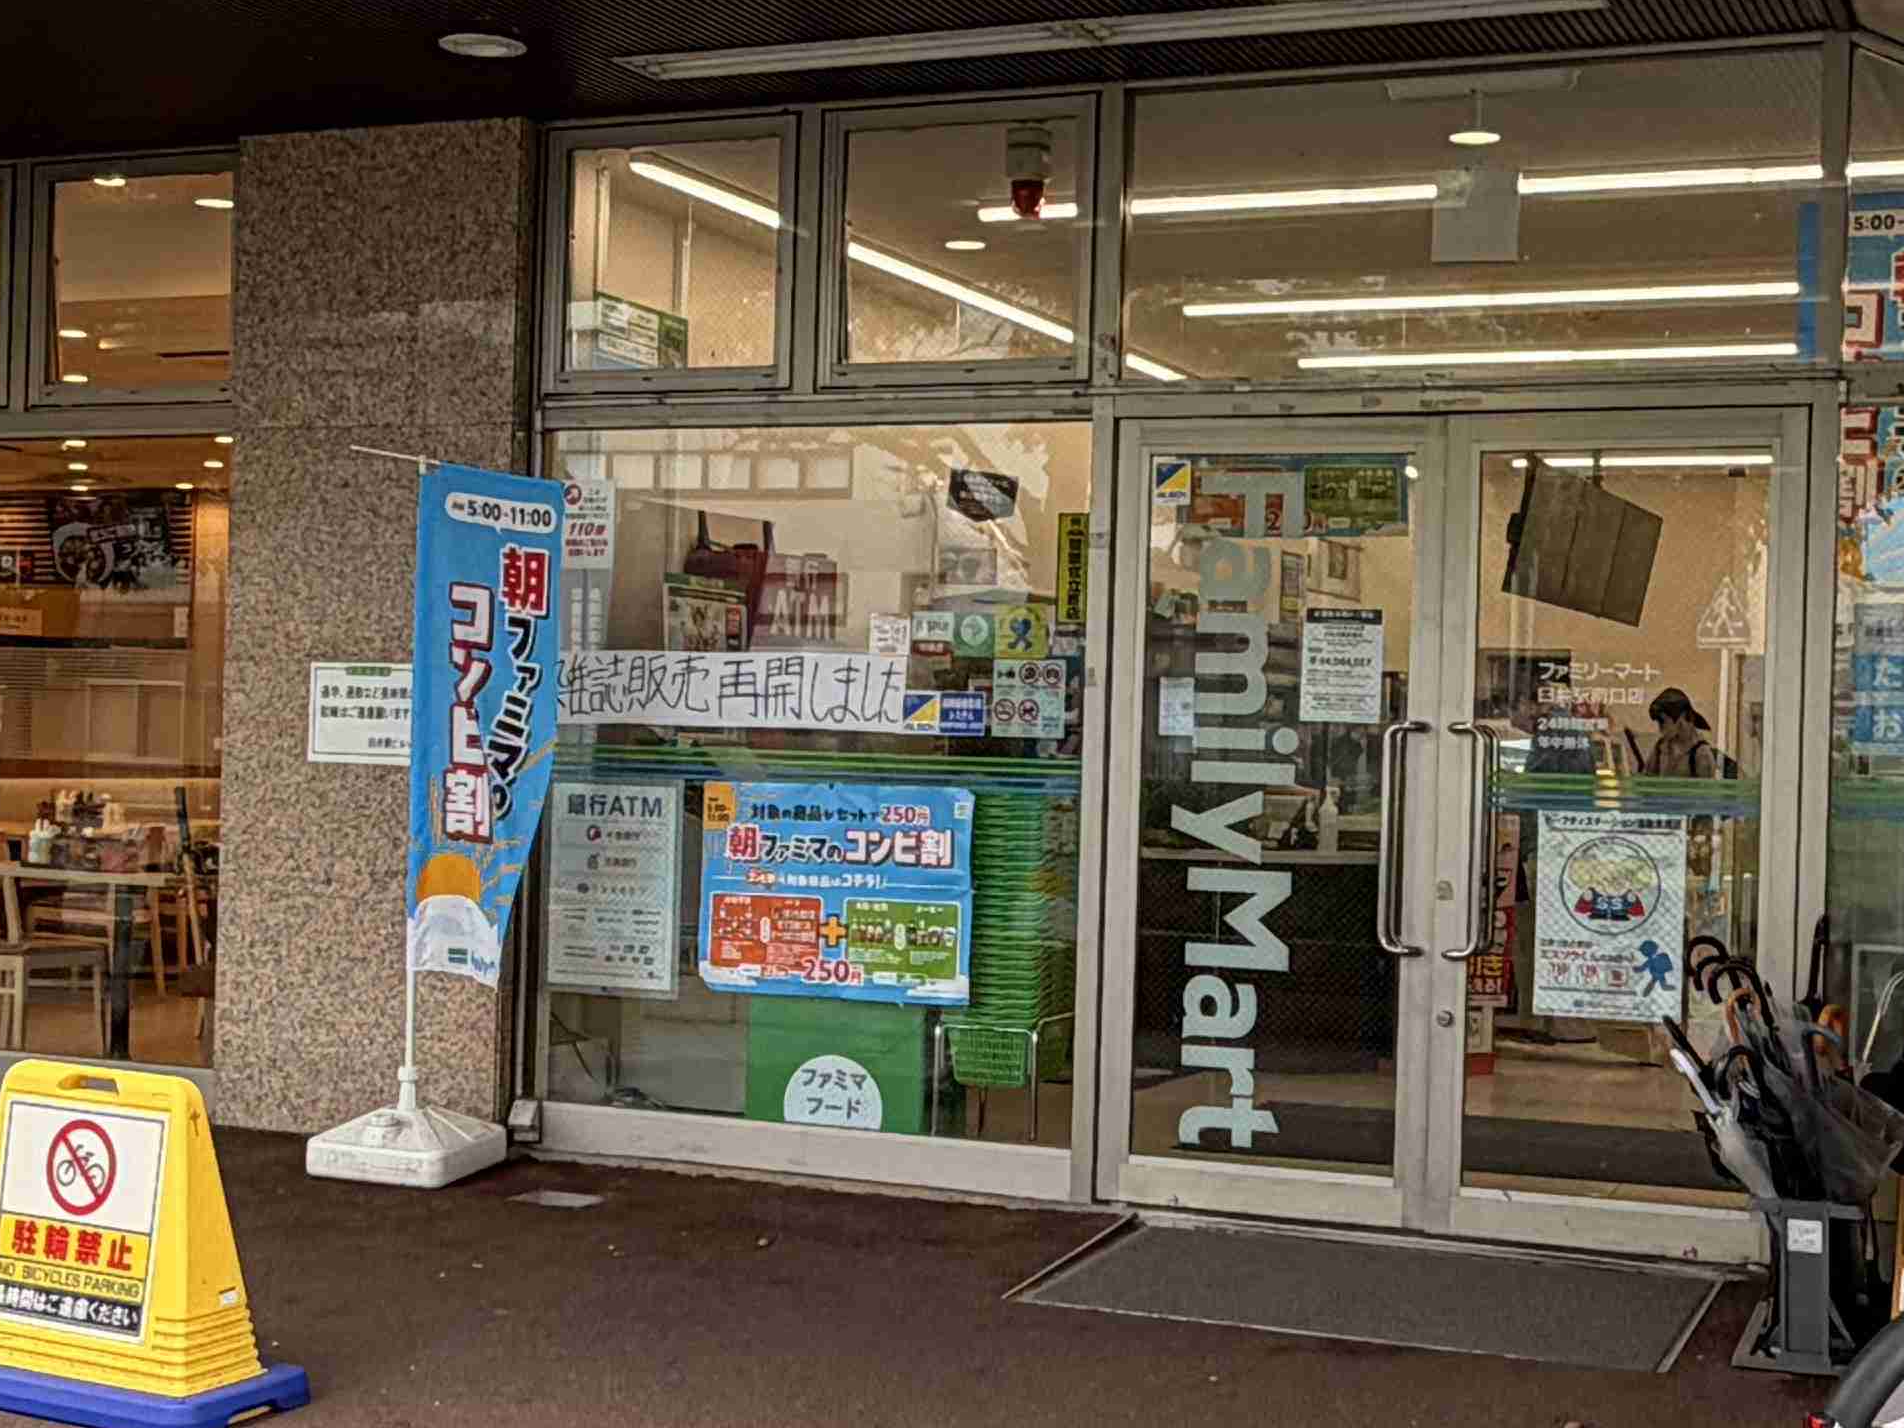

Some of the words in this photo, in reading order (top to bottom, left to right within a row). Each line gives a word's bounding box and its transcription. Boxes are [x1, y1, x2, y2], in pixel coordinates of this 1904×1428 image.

[467, 500, 552, 527] 5:00-11:00
[1537, 661, 1662, 681] ファミリーマート
[557, 654, 898, 723] 雑誌販売再開しました
[567, 794, 663, 819] 銀行ATM
[880, 803, 930, 827] 250円
[1170, 472, 1304, 1149] FamilyMart
[802, 958, 863, 985] 250円
[802, 1069, 867, 1091] ファミマ
[807, 1096, 862, 1118] フード
[12, 1220, 133, 1271] 駐輪禁止
[22, 1265, 81, 1288] BICYCLES
[83, 1276, 140, 1298] PARKING
